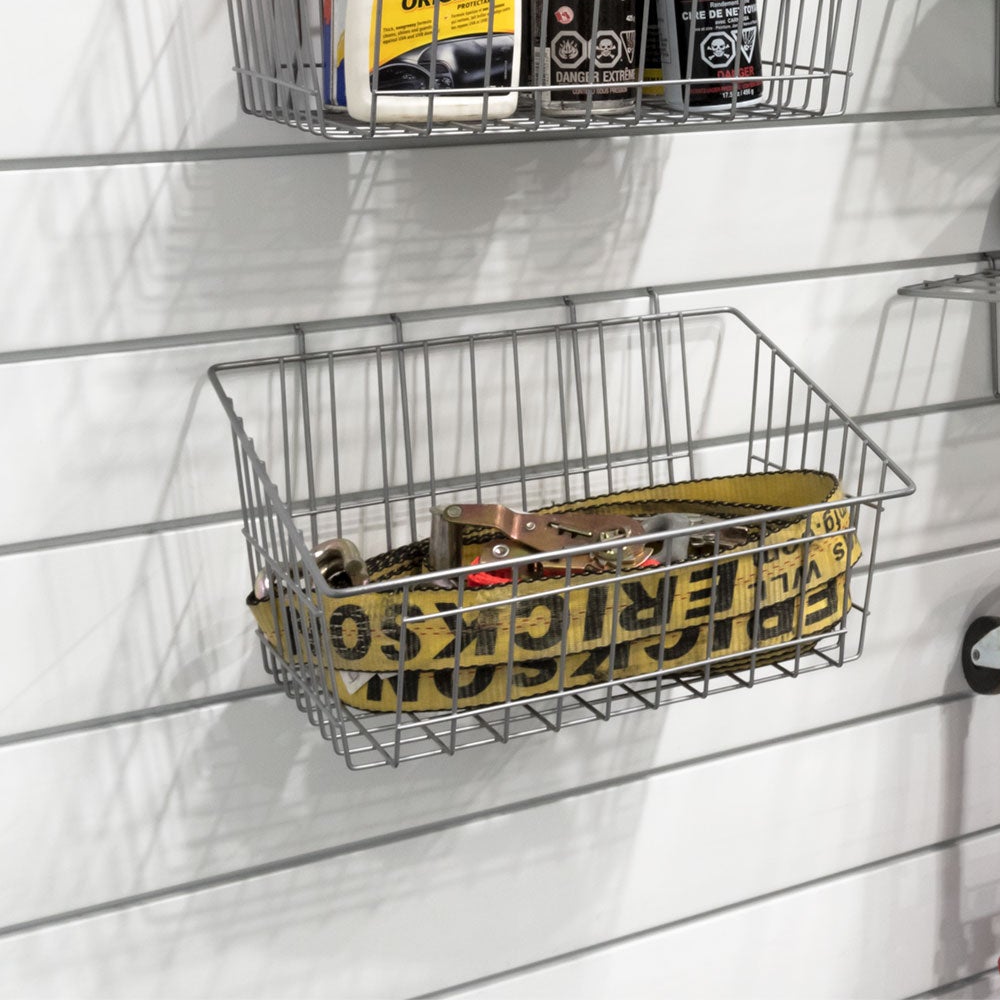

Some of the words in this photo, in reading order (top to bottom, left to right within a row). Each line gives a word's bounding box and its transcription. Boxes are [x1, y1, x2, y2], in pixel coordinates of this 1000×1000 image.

[682, 10, 706, 21] CIRE
[709, 9, 723, 19] DE
[556, 72, 600, 83] DANGER
